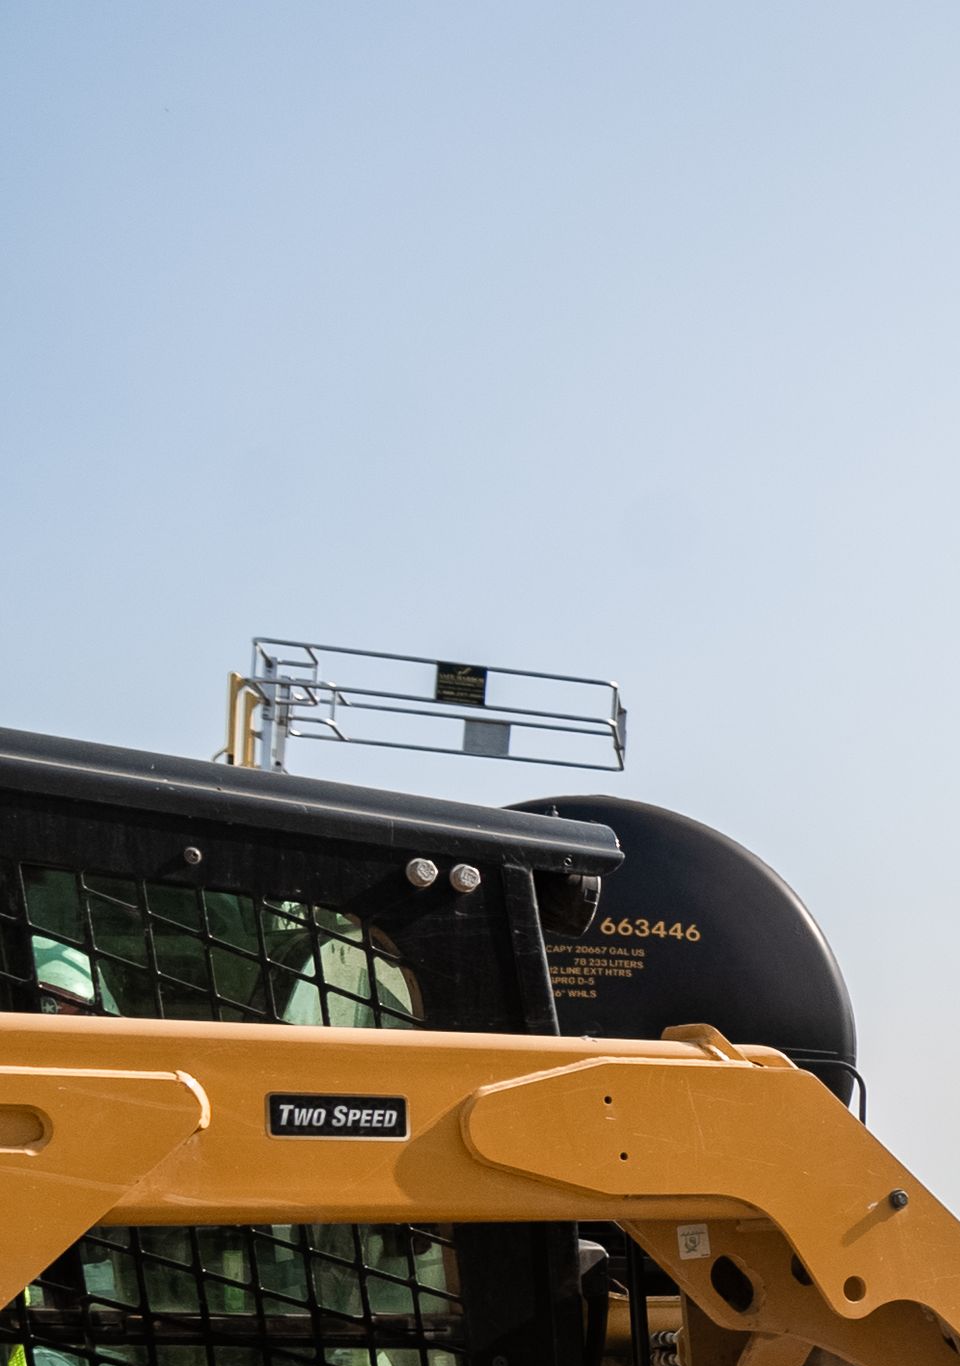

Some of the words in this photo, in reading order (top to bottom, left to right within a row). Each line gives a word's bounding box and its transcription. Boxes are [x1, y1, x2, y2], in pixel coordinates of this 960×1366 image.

[600, 917, 701, 942] 663446
[545, 944, 573, 953] CAPY
[609, 946, 630, 956] GAL
[631, 948, 645, 957] US
[609, 959, 644, 969] LITERS
[560, 967, 582, 975] LINE
[583, 967, 603, 976] EXT
[605, 968, 632, 977] HTRS
[279, 1104, 327, 1127] TWO
[331, 1105, 398, 1128] SPEED
